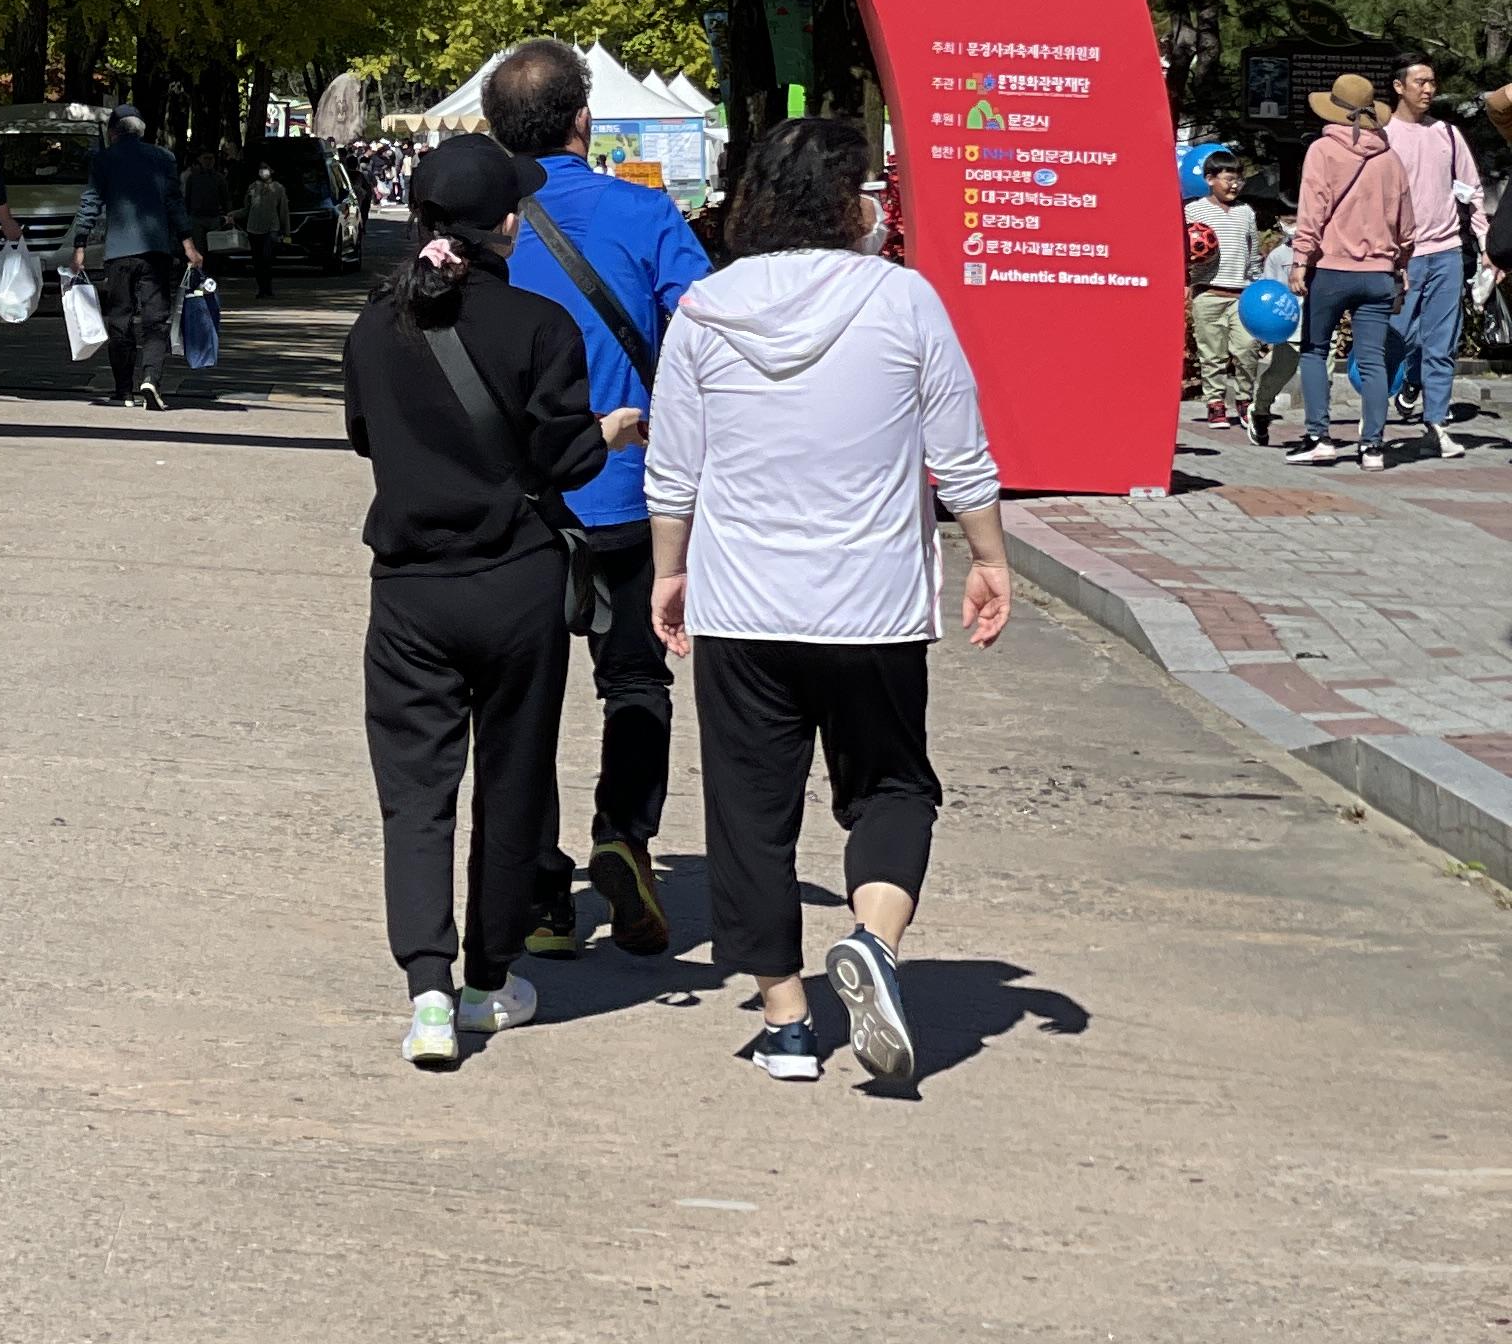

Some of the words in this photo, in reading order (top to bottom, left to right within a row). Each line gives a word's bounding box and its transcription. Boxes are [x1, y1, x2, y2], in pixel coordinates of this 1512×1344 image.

[931, 41, 955, 55] 주최
[967, 42, 1100, 62] 문경사과축제추진위원회
[931, 77, 954, 90] 주관
[998, 74, 1090, 93] 문경문화관광재단
[931, 112, 954, 126] 후원
[1008, 113, 1049, 128] 문경시
[1016, 148, 1118, 165] 농협문경시지부
[982, 214, 1040, 230] 문경농협
[986, 240, 1109, 258] 문경사과발전협의회
[989, 269, 1055, 284] Authentic
[1058, 271, 1105, 286] Brands
[1108, 274, 1149, 288] Korea
